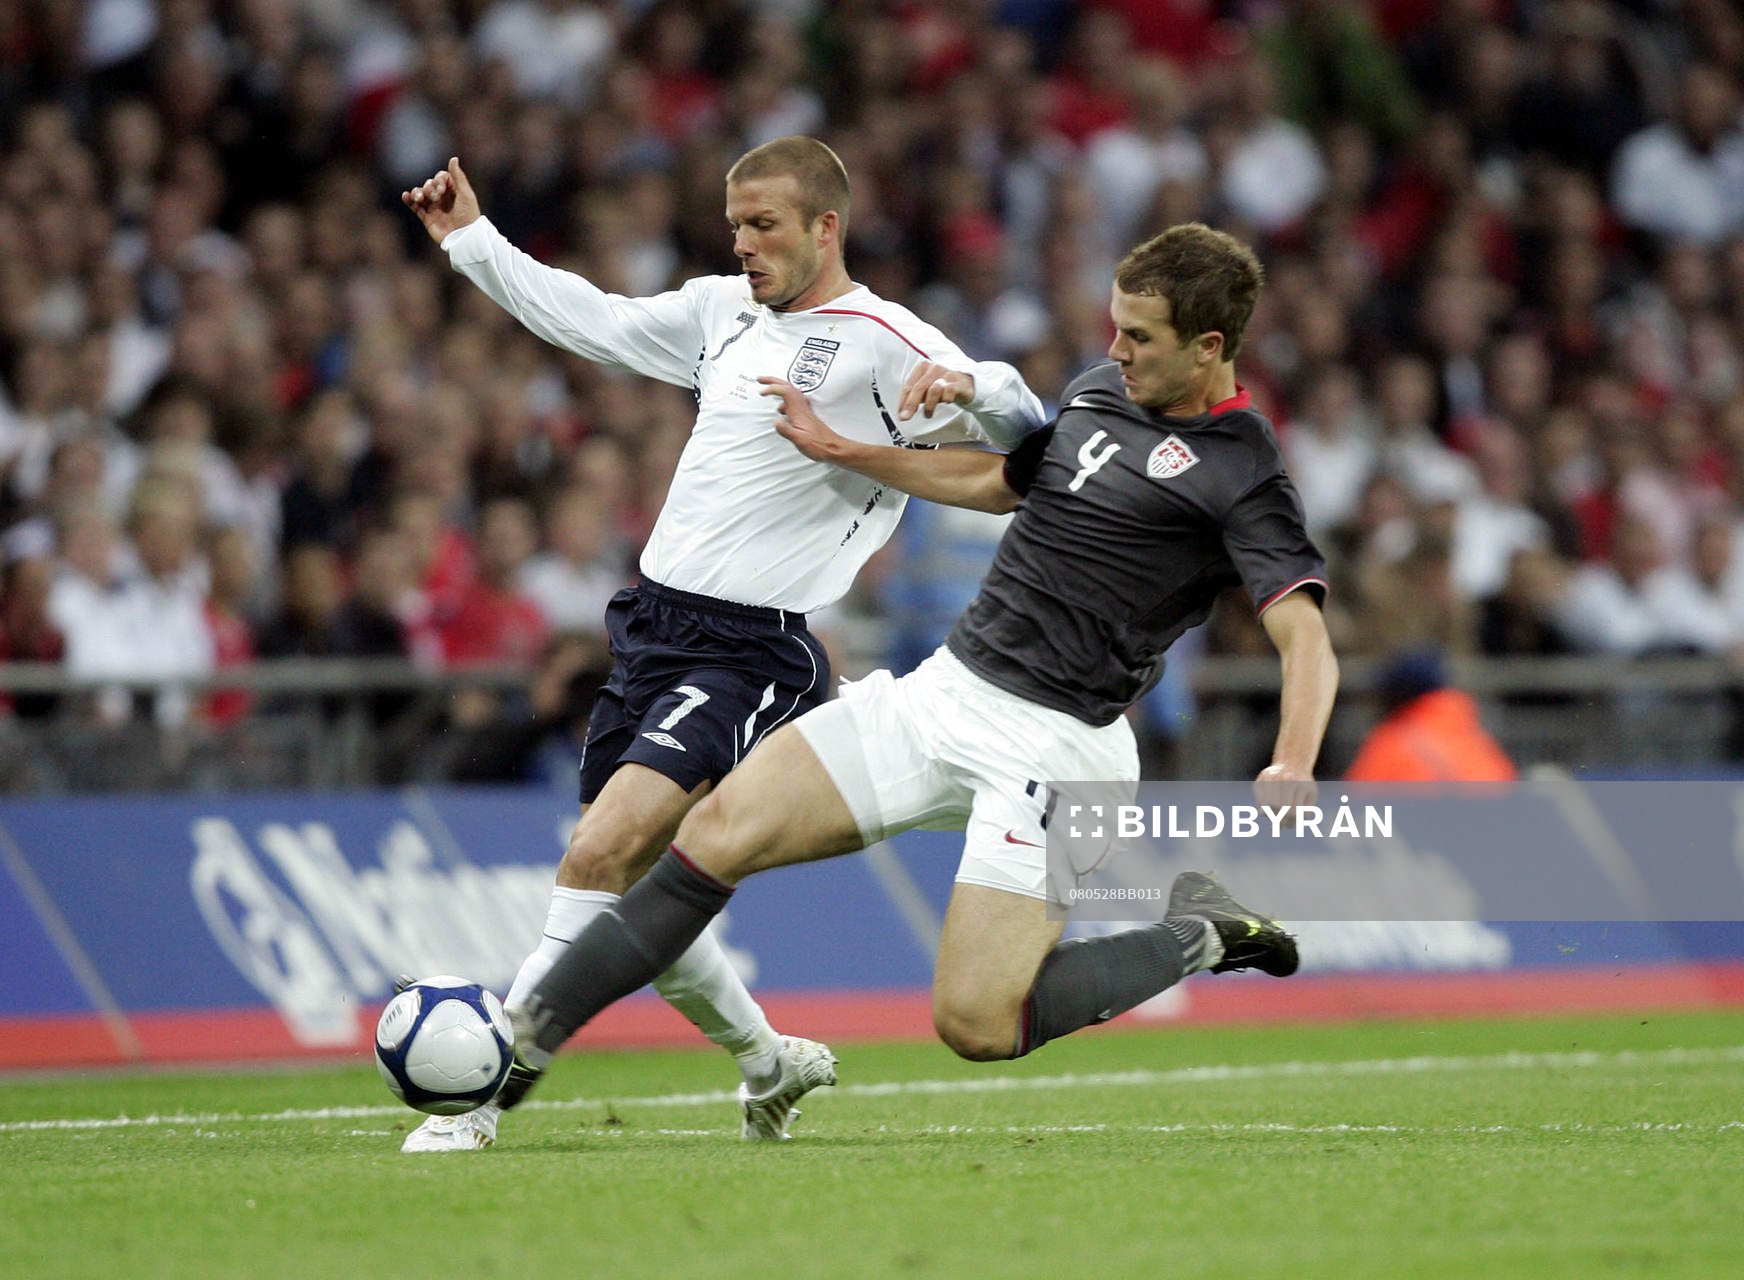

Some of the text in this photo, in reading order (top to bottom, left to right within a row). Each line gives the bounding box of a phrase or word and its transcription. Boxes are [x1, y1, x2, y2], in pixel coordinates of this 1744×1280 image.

[710, 311, 758, 361] 7
[1068, 430, 1122, 492] 4
[657, 685, 711, 731] 7
